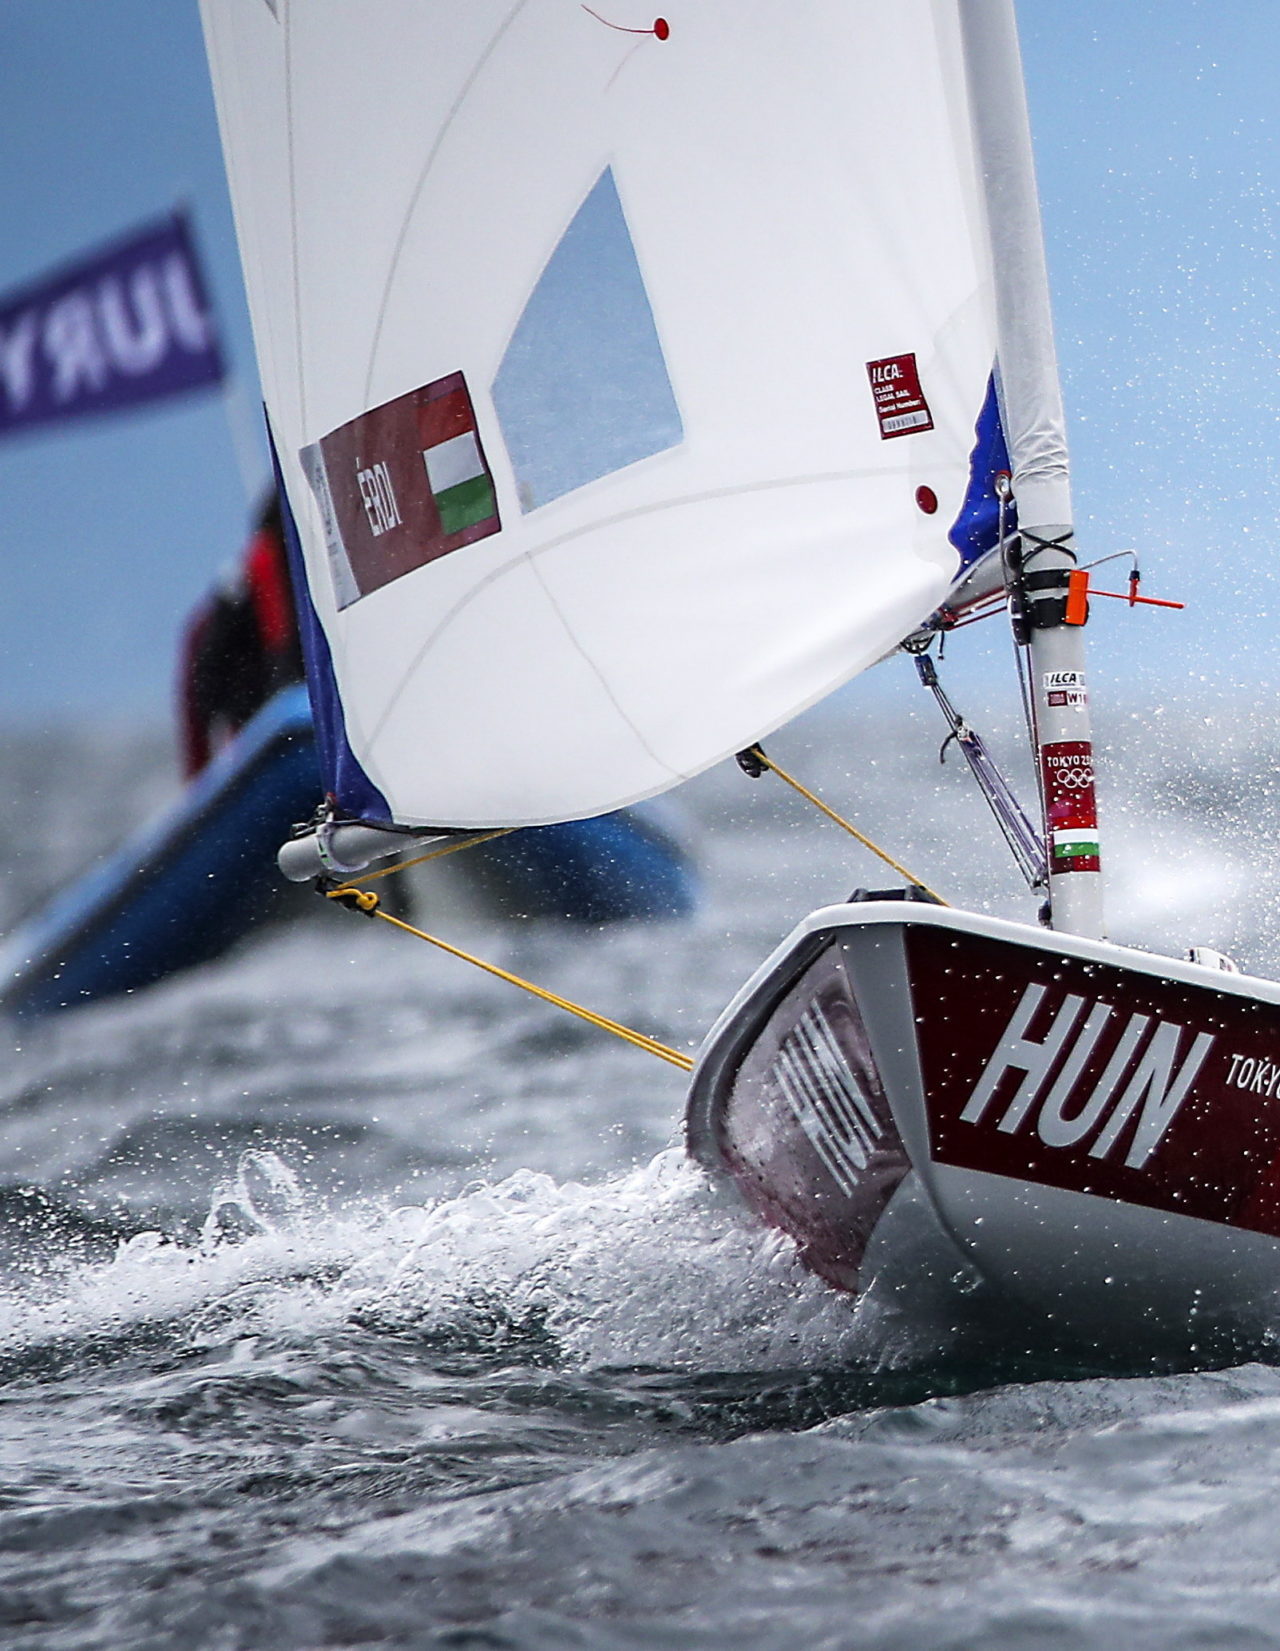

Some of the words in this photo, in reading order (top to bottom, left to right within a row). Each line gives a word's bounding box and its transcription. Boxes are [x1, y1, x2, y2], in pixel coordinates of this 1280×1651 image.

[872, 363, 900, 384] ILCA
[356, 456, 404, 537] ÉRDI
[1050, 672, 1077, 684] ILCA
[1046, 755, 1080, 768] TOKYO
[772, 997, 884, 1200] HUN
[959, 982, 1216, 1171] HUN
